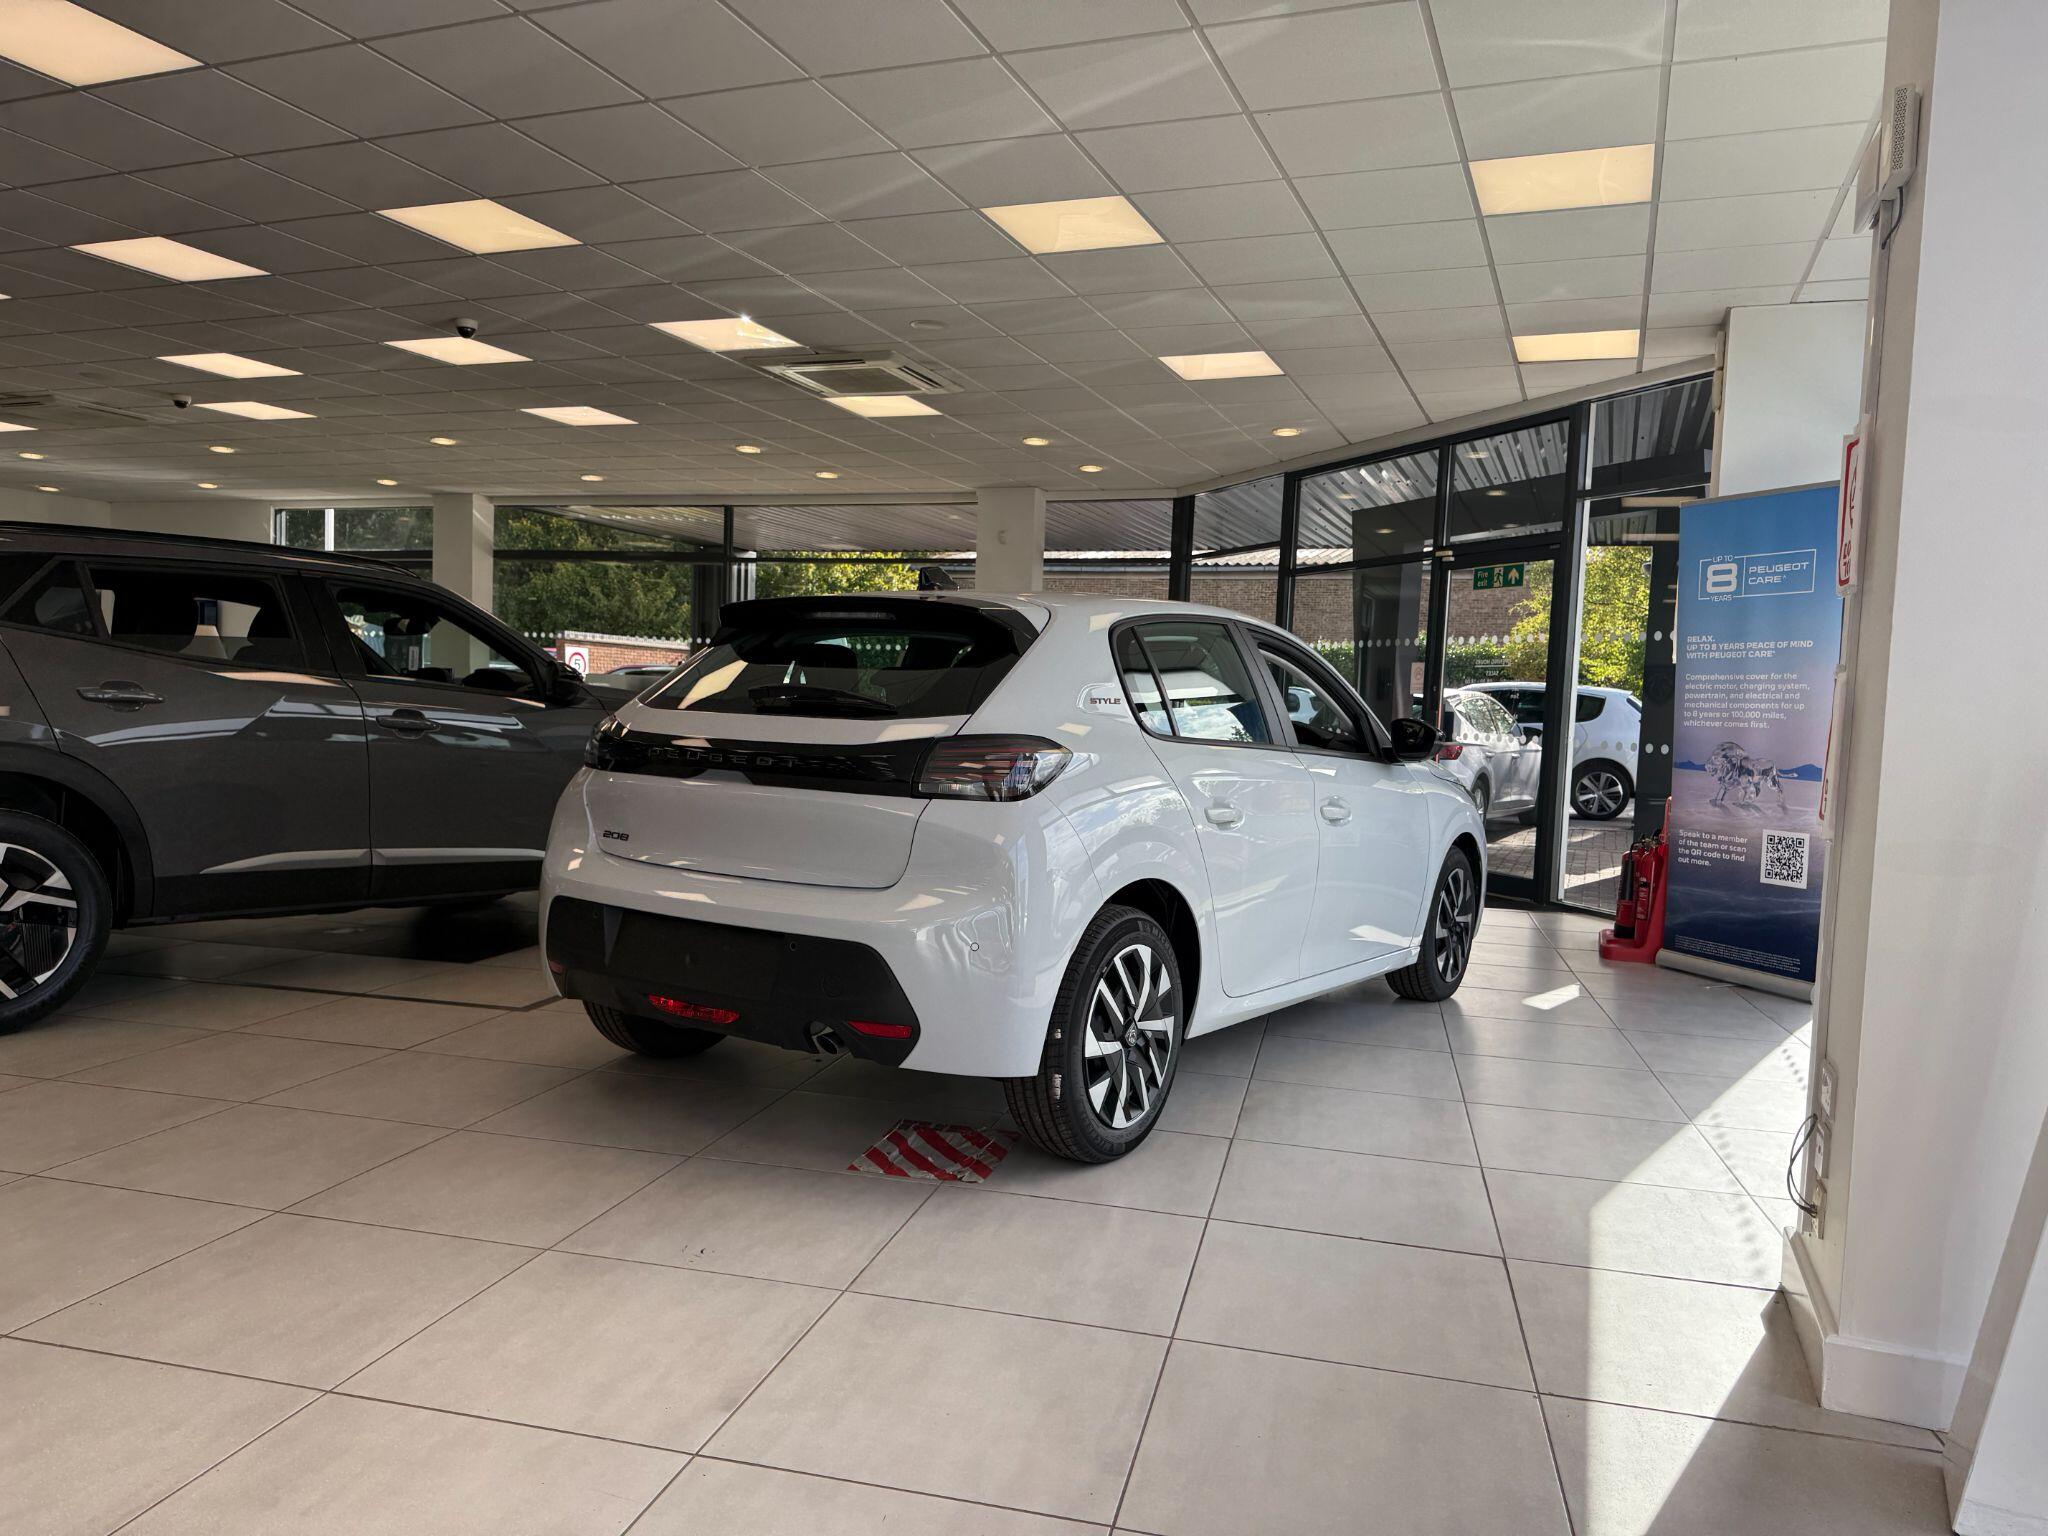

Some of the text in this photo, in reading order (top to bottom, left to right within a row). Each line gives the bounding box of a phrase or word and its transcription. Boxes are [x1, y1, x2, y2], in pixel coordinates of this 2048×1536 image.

[1748, 562, 1810, 574] PEUGEOT
[1477, 571, 1488, 579] Fire
[1706, 563, 1738, 594] 8
[1687, 635, 1715, 643] RELAX.
[1700, 643, 1710, 651] TO
[1719, 642, 1745, 650] YEARS
[1746, 641, 1775, 649] PEACE
[1789, 640, 1814, 648] MIND
[1709, 651, 1747, 659] PEUGEOT
[574, 658, 581, 670] 5
[1685, 673, 1745, 681] Comprehensive
[1770, 672, 1783, 680] for
[1783, 672, 1798, 680] the
[1685, 682, 1810, 691] electric motor, charging system,
[1089, 697, 1121, 705] STYLE
[1684, 692, 1728, 700] powertrain,
[1745, 692, 1783, 700] electrical
[1784, 692, 1800, 700] and
[1684, 701, 1805, 711] mechanical components for up
[1699, 711, 1720, 719] years
[1762, 711, 1787, 720] miles,
[1750, 720, 1770, 729] first.
[647, 746, 798, 768] PEUGEOT
[602, 830, 630, 841] 208
[1679, 829, 1701, 838] Speak
[1717, 834, 1748, 844] member
[1686, 839, 1699, 847] the
[1700, 841, 1719, 849] team
[1729, 845, 1747, 853] scan
[1678, 847, 1690, 855] the
[1690, 848, 1702, 856] QR
[1703, 850, 1721, 859] code
[1731, 853, 1746, 862] find
[1677, 856, 1712, 867] out more.
